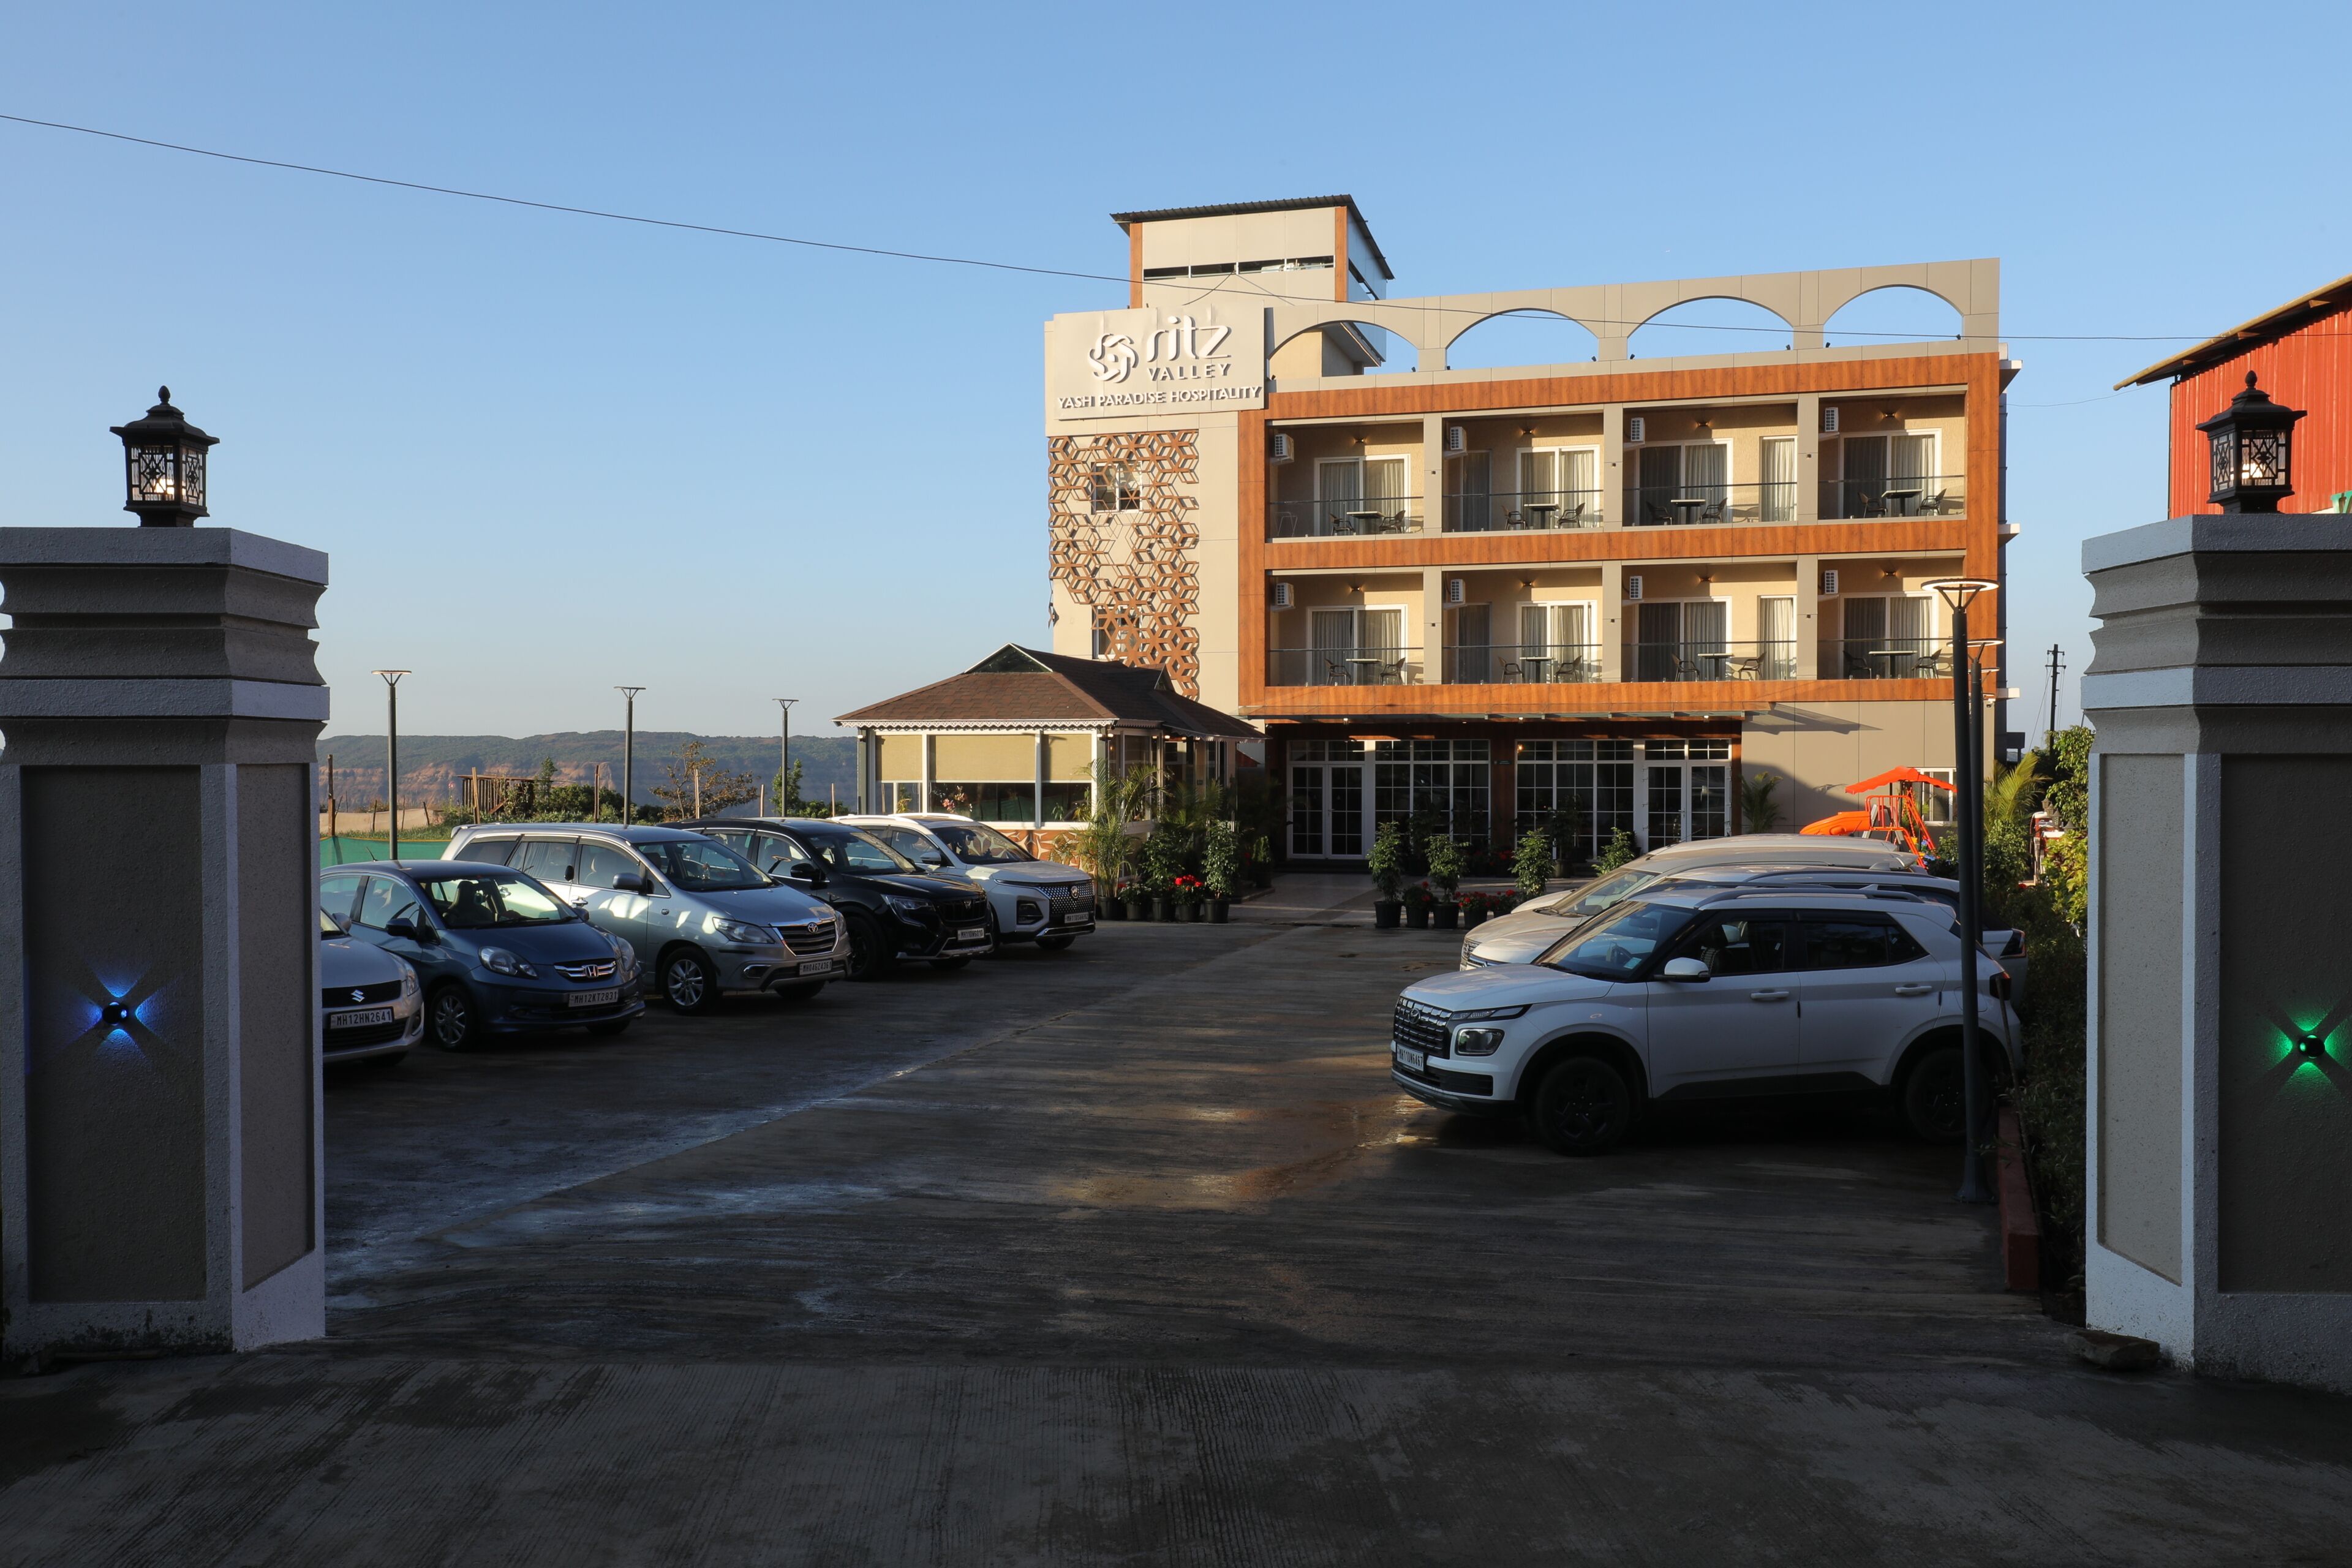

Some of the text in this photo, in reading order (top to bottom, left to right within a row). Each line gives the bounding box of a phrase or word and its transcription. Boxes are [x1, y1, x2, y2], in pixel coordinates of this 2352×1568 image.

[1147, 315, 1231, 362] ritz
[1147, 363, 1231, 381] VALLEY
[1058, 385, 1262, 409] YASH PARADISE HOSPITALITY
[803, 961, 832, 972] MH04GZ4361
[575, 991, 617, 1003] MH12KT2831
[337, 1011, 391, 1026] MH12HN2641
